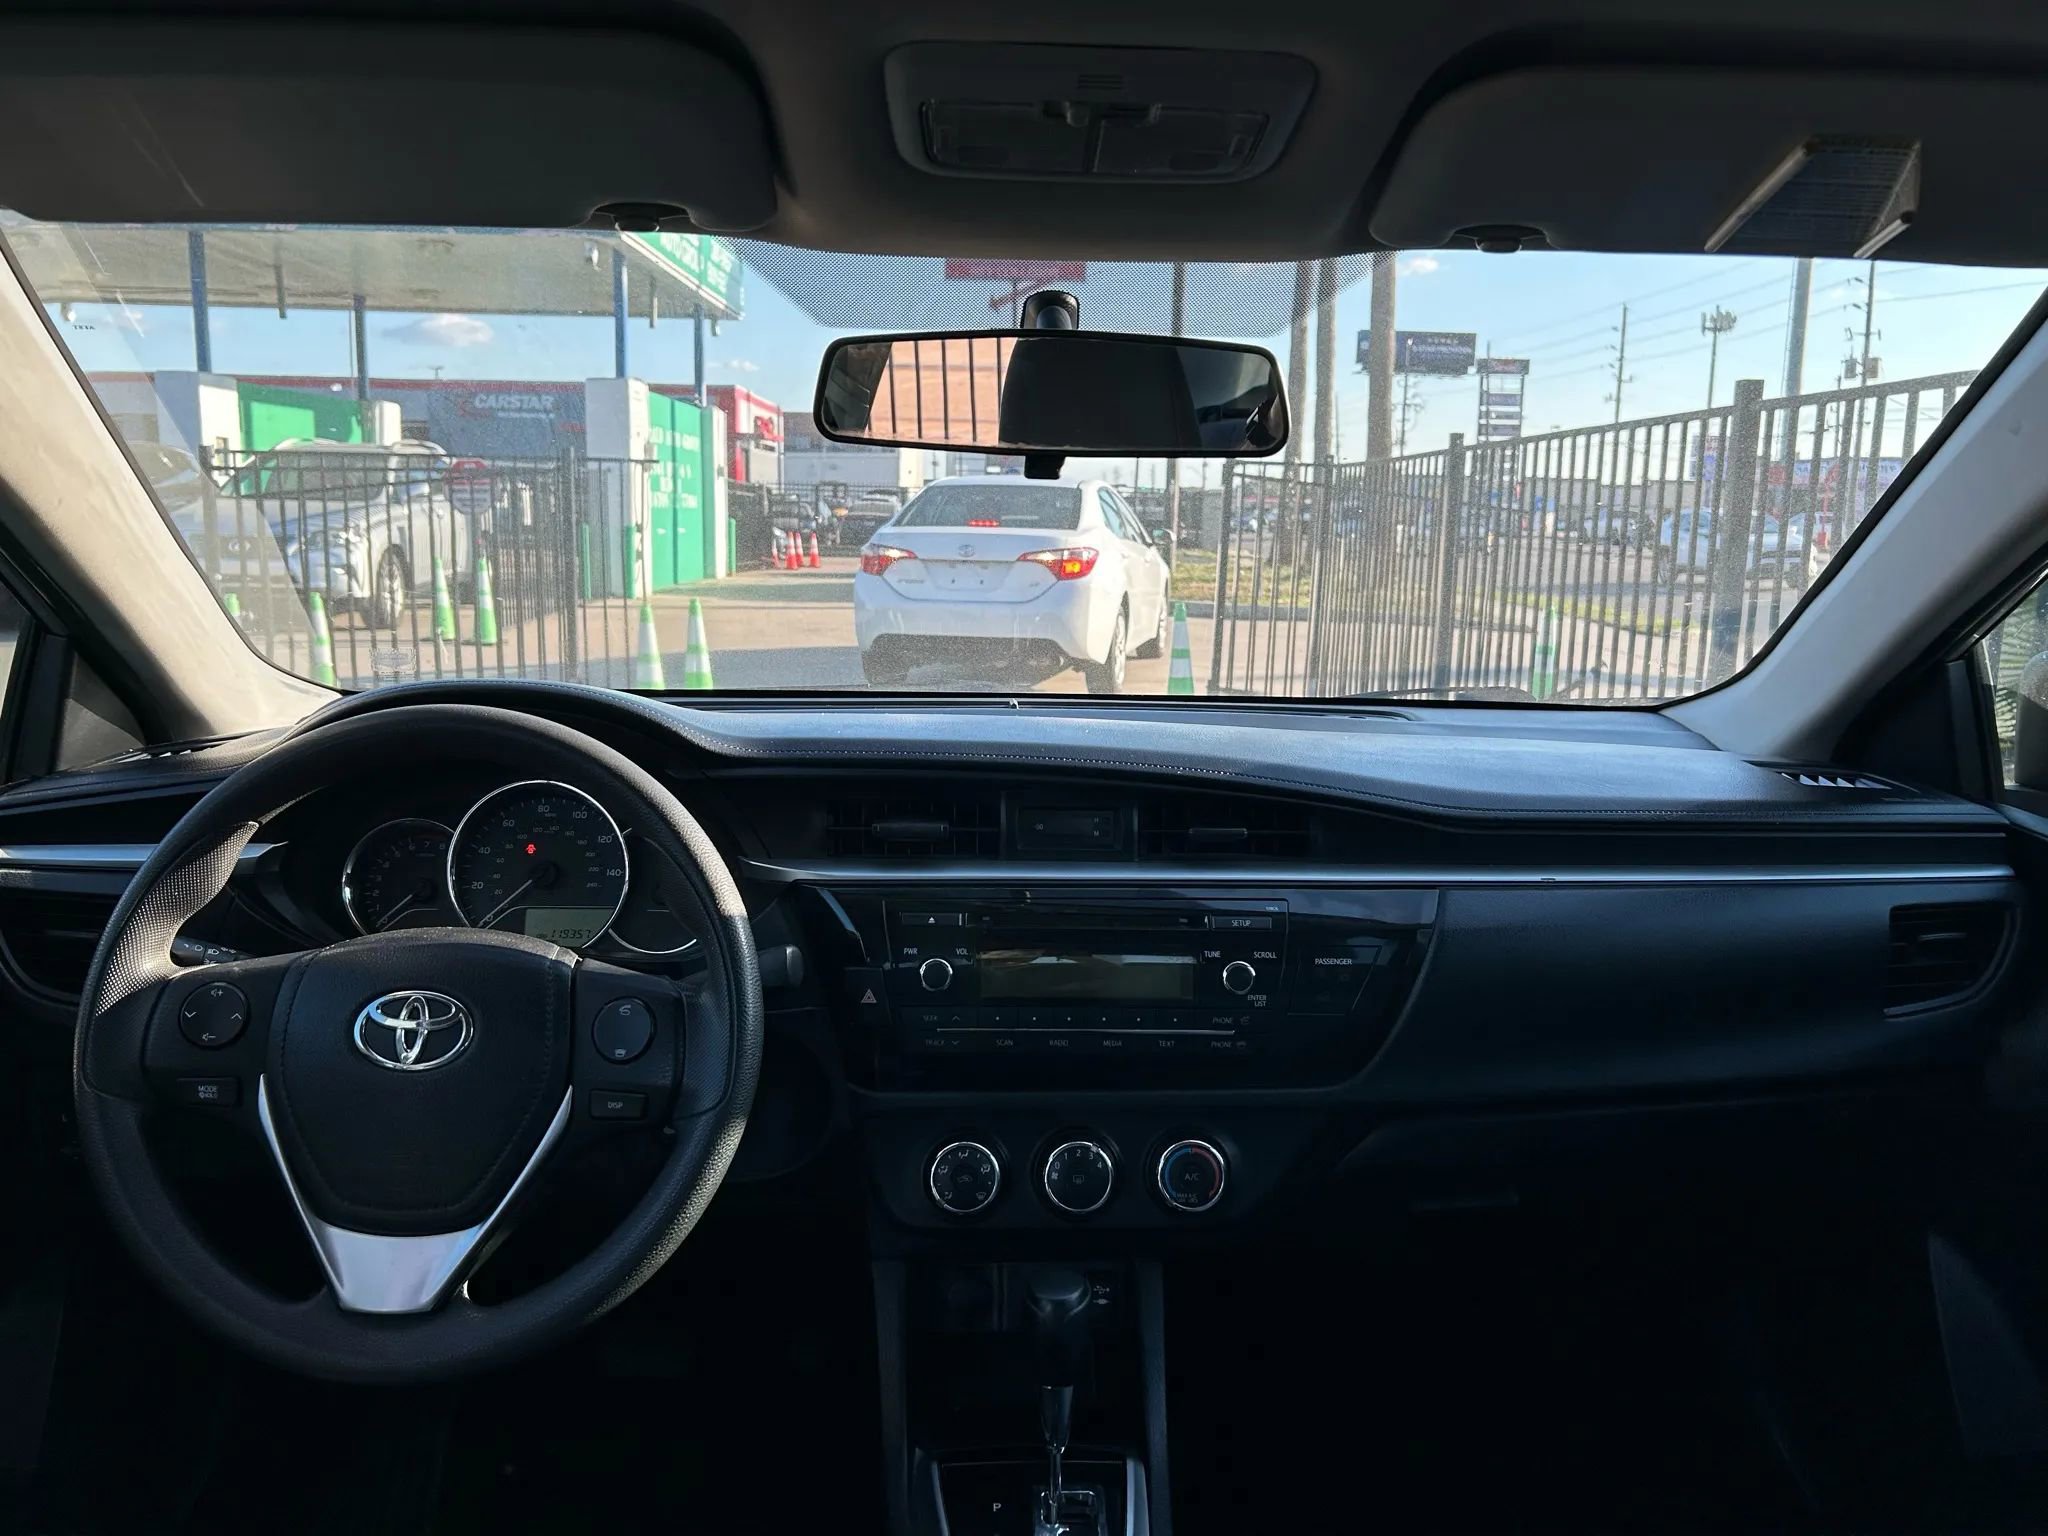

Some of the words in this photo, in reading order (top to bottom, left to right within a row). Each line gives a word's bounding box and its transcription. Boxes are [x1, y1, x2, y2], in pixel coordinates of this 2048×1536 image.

[475, 393, 554, 410] CARSTAR
[538, 804, 550, 812] 80
[572, 811, 588, 819] 100
[598, 836, 613, 844] 120
[478, 846, 491, 854] 40
[606, 868, 620, 877] 140
[472, 881, 484, 890] 20
[552, 928, 591, 939] 119357
[956, 948, 968, 956] VOL
[1204, 950, 1220, 958] TUNE
[1103, 1040, 1122, 1048] MEDIA
[1159, 1040, 1175, 1048] TEXT
[608, 1101, 624, 1109] DISP
[1076, 1149, 1081, 1157] 2
[1088, 1152, 1094, 1160] 3
[1054, 1162, 1060, 1170] 0
[1184, 1172, 1200, 1180] A/C
[992, 1502, 1002, 1512] P
